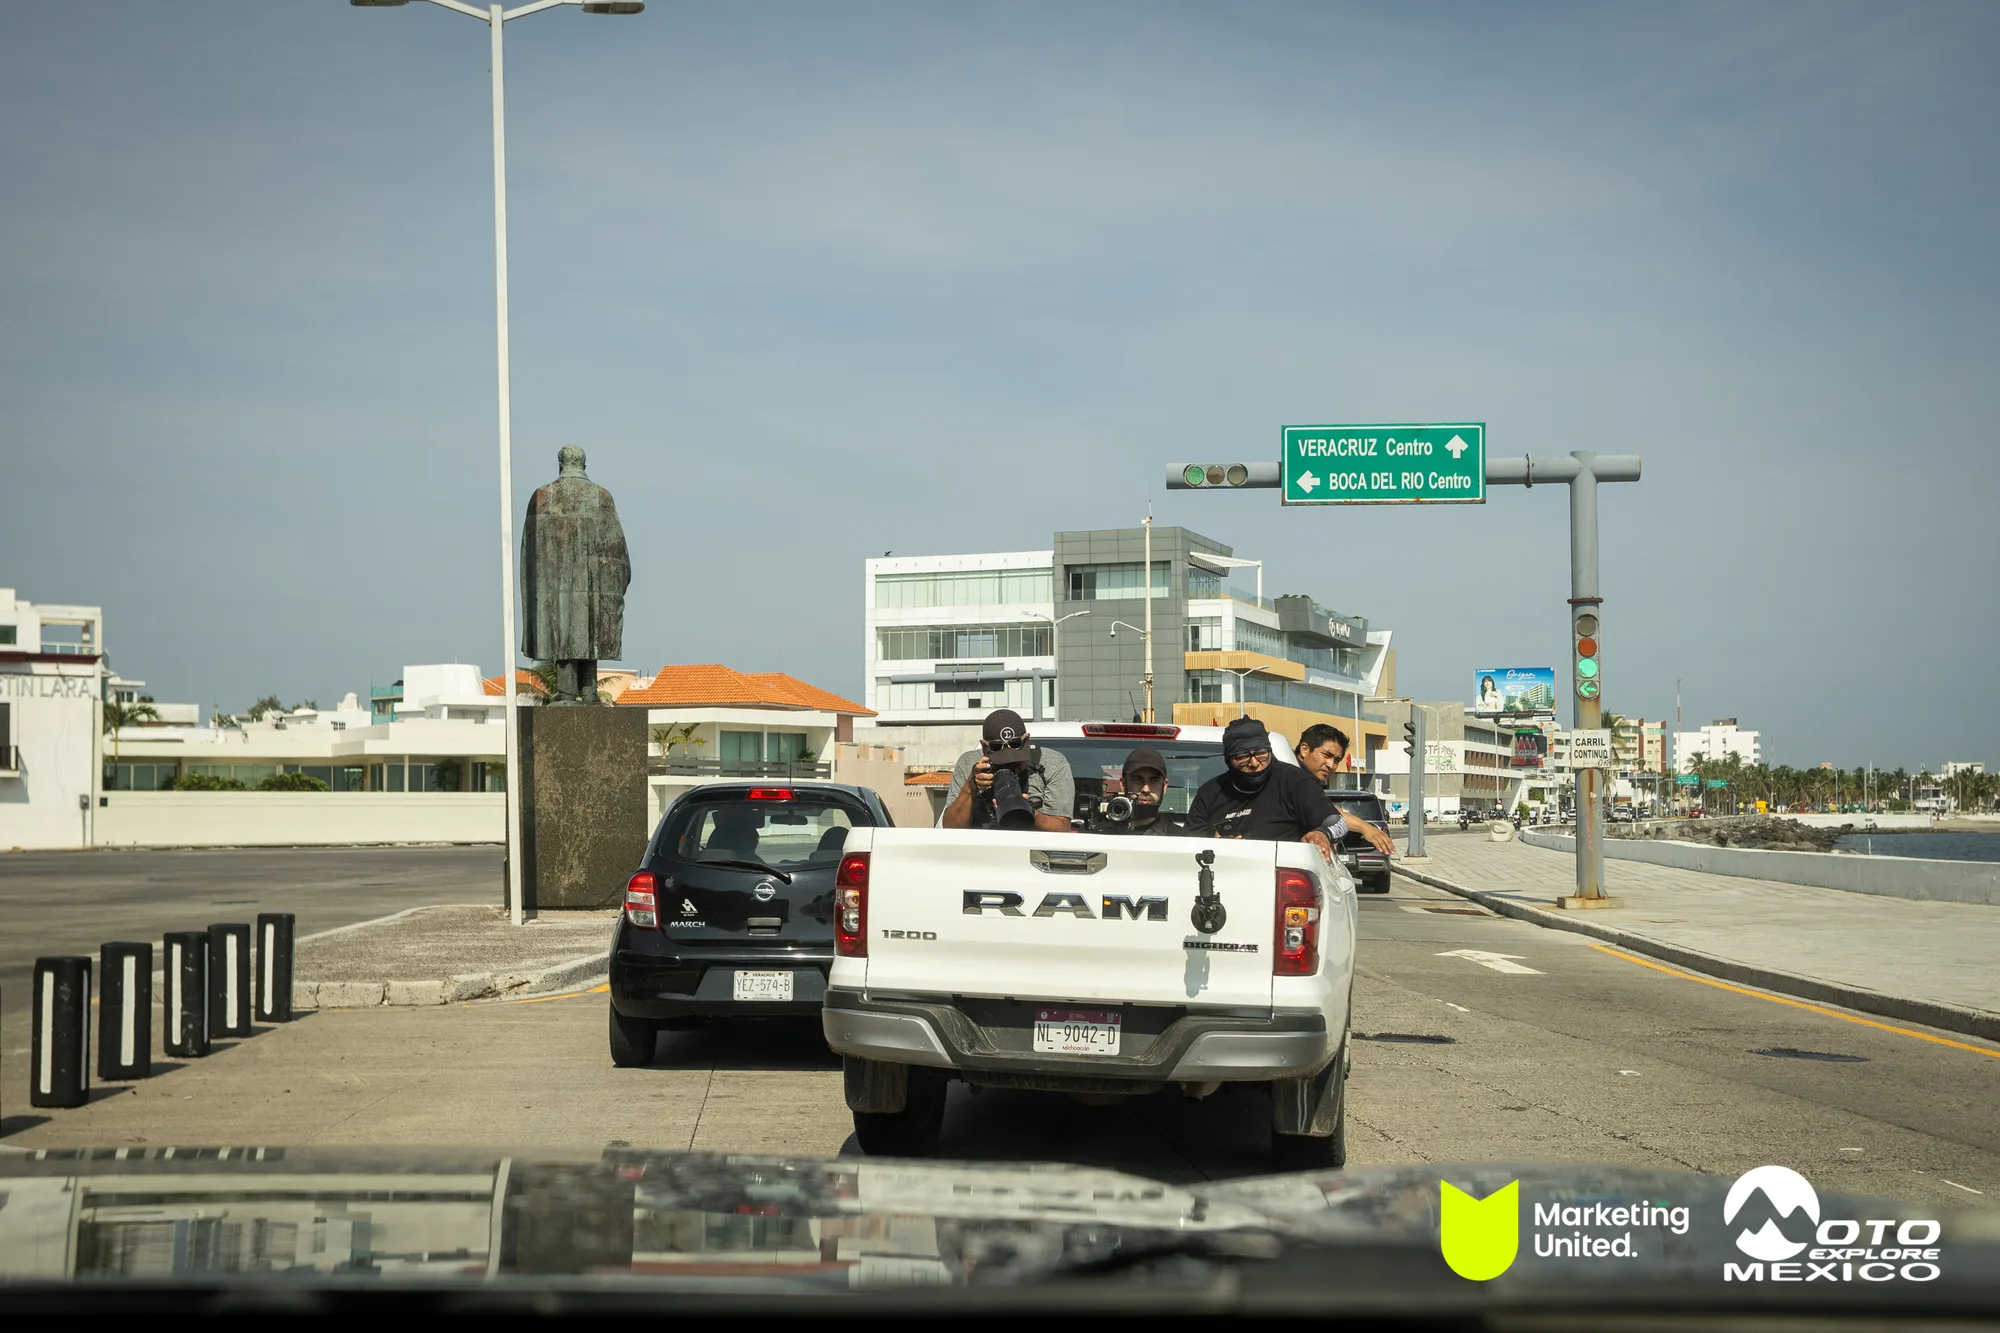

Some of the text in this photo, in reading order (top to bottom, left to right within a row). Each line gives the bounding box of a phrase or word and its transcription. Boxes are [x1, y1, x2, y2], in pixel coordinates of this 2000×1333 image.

[1298, 438, 1433, 457] VERACRUZ Centro
[1329, 472, 1471, 490] BOCA DEL RIO Centro
[0, 676, 92, 698] TIN LARA
[1575, 737, 1605, 746] CARRIL
[963, 889, 1169, 921] RAM
[881, 929, 937, 941] 1200
[737, 978, 790, 992] YEZ-574-B
[1037, 1023, 1116, 1045] NL-9042-D
